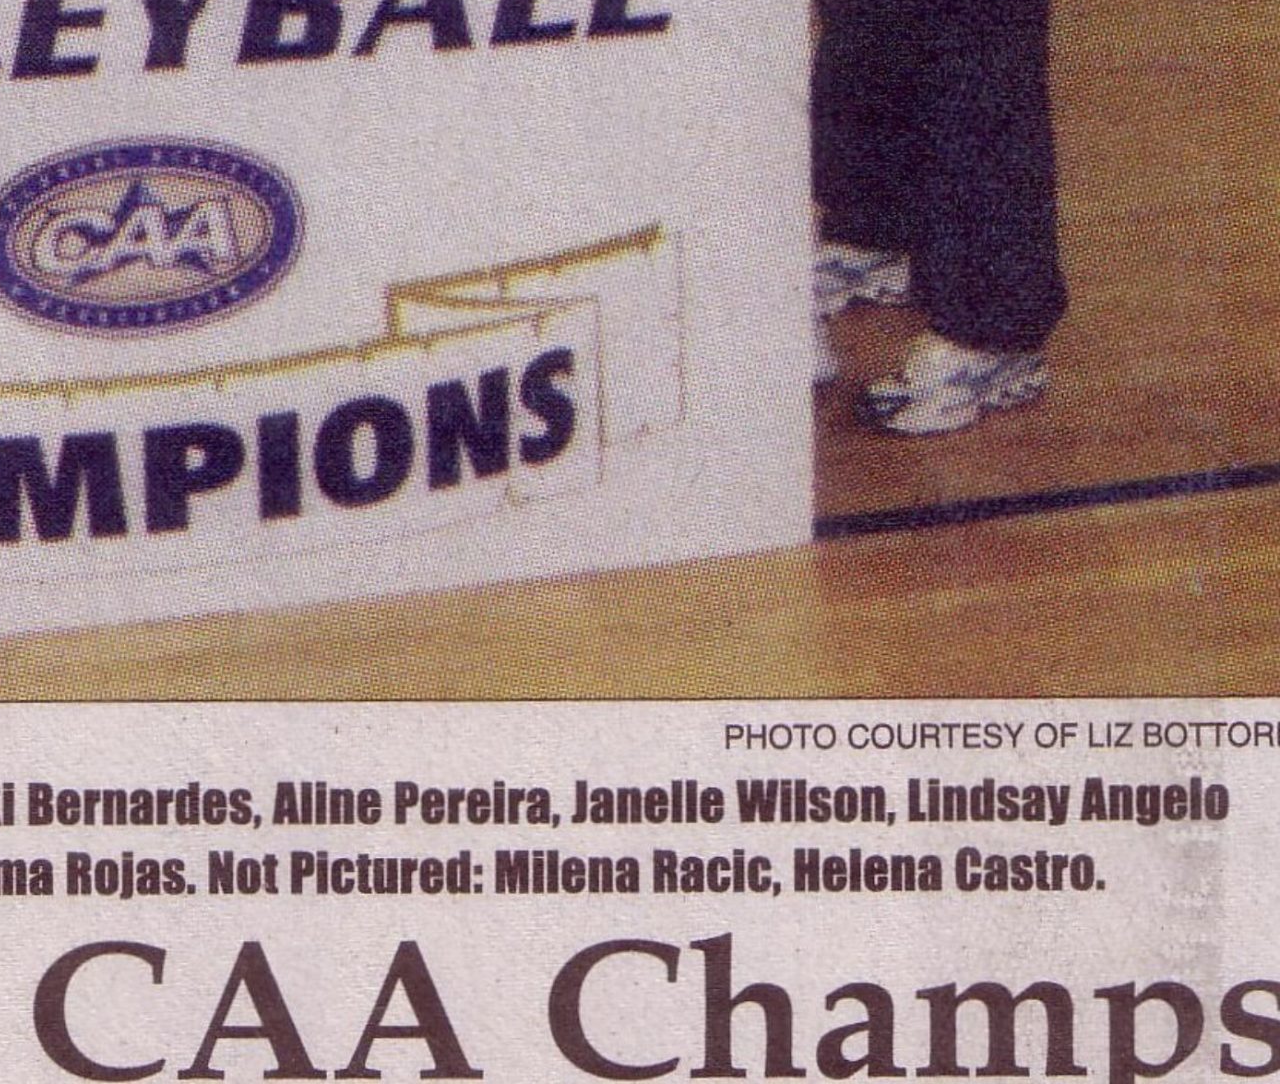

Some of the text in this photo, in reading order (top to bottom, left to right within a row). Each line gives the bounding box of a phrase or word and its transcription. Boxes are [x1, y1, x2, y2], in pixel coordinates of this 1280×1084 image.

[32, 194, 241, 273] CAA
[725, 720, 1280, 751] PHOTO COURTESY OF LIZ BOTTOR
[29, 782, 261, 828] Bernardes,
[273, 782, 381, 824] Aline
[395, 781, 560, 827] Pereira,
[572, 780, 724, 823] Janelle
[737, 780, 895, 825] Wilson,
[909, 779, 1070, 825] Lindsay
[1081, 777, 1229, 826] Angelo
[67, 852, 195, 899] Rojas.
[209, 851, 278, 894] Not
[291, 851, 482, 894] Pictured:
[496, 850, 639, 893] Milena
[653, 849, 781, 897] Racic,
[794, 849, 942, 892] Helena
[955, 847, 1106, 892] Castro.
[33, 940, 484, 1083] CAA
[548, 932, 1280, 1084] Champs
